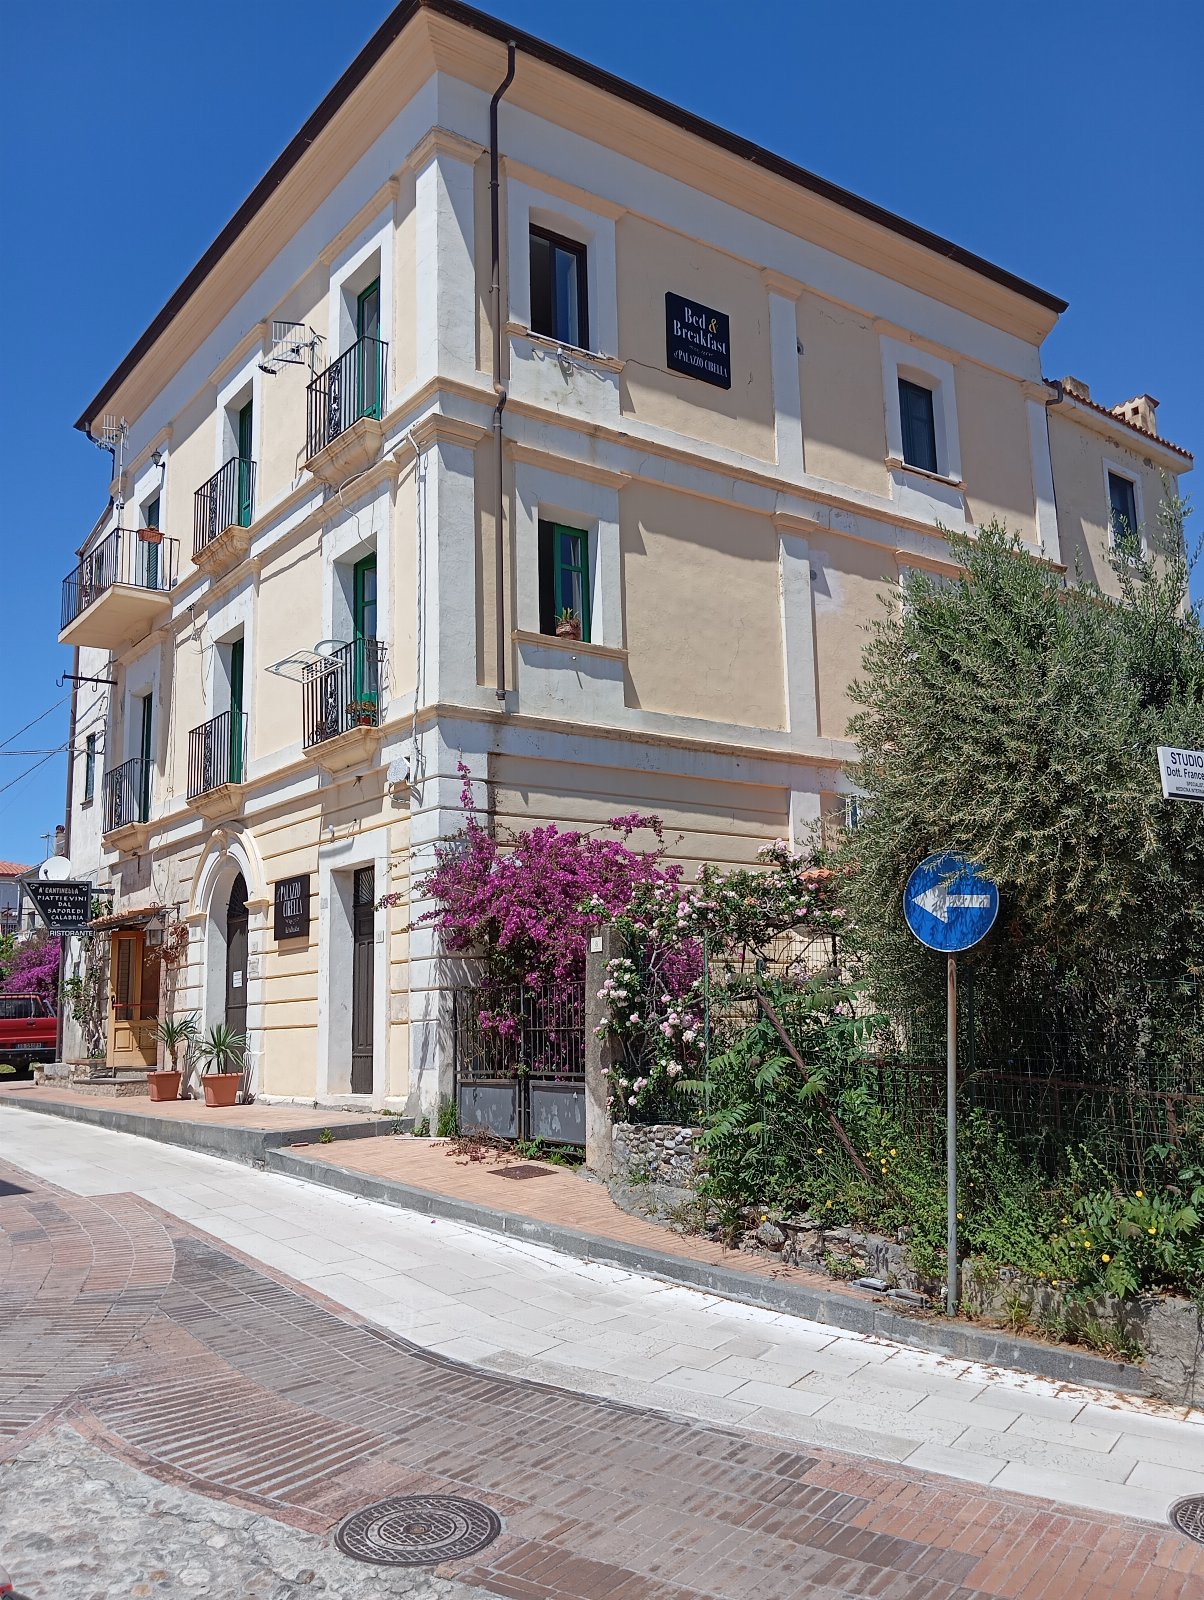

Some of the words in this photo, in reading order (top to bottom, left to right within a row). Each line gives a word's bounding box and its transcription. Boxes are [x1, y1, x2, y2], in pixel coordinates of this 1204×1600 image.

[684, 307, 706, 329] Bed
[708, 318, 718, 334] &
[673, 319, 727, 355] Breakfast
[678, 350, 704, 369] PALAZZO
[704, 359, 728, 378] CIBELLA
[1170, 751, 1203, 768] STUDIO
[44, 887, 79, 895] CANTINELLA
[280, 881, 301, 902] PALAZZO
[282, 899, 303, 917] CIBELLA
